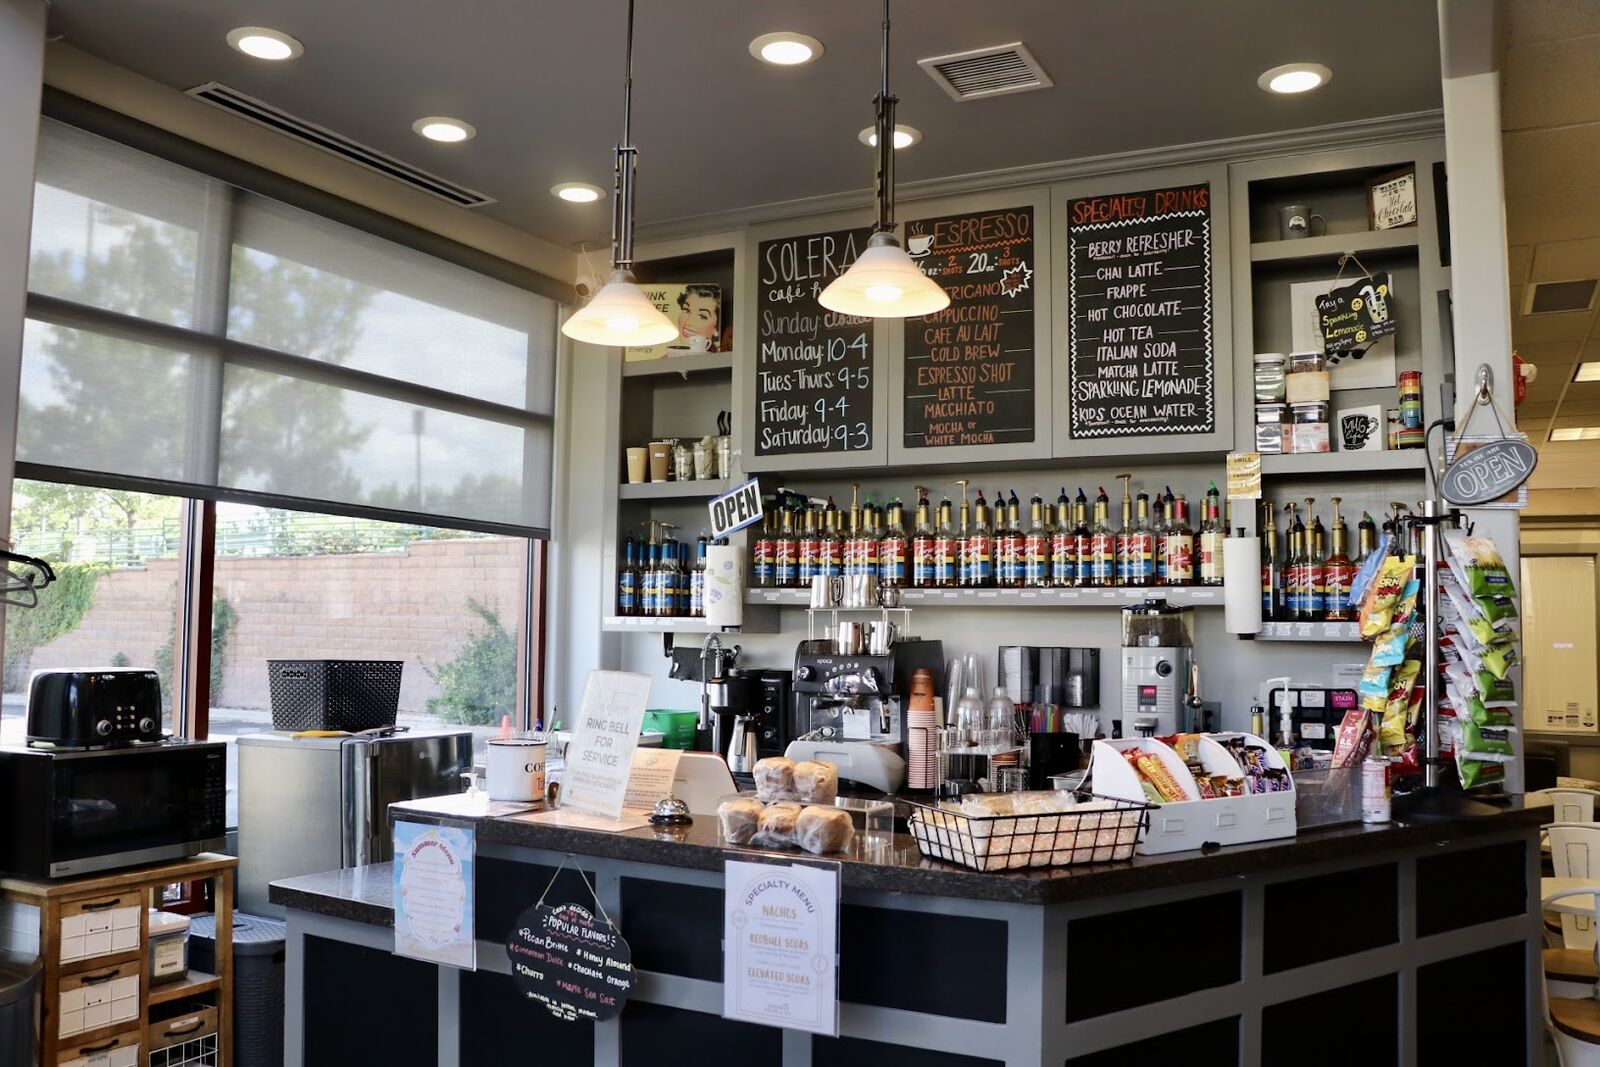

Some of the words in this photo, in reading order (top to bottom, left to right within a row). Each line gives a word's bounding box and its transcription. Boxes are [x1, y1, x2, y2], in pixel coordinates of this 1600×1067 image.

[1072, 196, 1146, 224] SPECIALTY
[1155, 188, 1209, 215] DRINKS
[934, 213, 1029, 248] ESPRESSO
[1003, 246, 1010, 257] 3
[1088, 240, 1121, 258] BERRY
[1126, 229, 1195, 253] REFRESHER
[763, 233, 858, 285] SOLERA
[948, 255, 956, 266] 2
[1097, 267, 1122, 280] CHAI
[1128, 262, 1163, 278] LATTE
[1107, 284, 1147, 300] FRAPPE
[923, 305, 998, 323] CAPPUCCINO
[1088, 308, 1108, 321] HOT
[1114, 300, 1181, 319] CHOCOLATE
[924, 327, 954, 344] CAFE
[956, 325, 970, 343] AU
[974, 322, 1004, 341] LAIT
[1103, 328, 1125, 343] HOT
[1129, 326, 1153, 340] TEA
[762, 340, 825, 367] Monday:
[827, 332, 868, 362] 10-4
[931, 346, 960, 361] COLD
[965, 344, 1000, 361] BREW
[1097, 345, 1137, 361] ITALIAN
[1143, 342, 1176, 359] SODA
[838, 366, 869, 389] 9-5
[918, 366, 976, 386] ESPRESSO
[979, 362, 1016, 383] SHOT
[1098, 365, 1138, 379] MATCHA
[1143, 361, 1178, 376] LATTE
[939, 385, 975, 400] LATTE
[1078, 380, 1139, 401] SPARKLING
[1142, 377, 1202, 398] LEMONADE
[761, 400, 809, 425] Friday:
[815, 396, 850, 423] 9-4
[924, 401, 994, 418] MACCHIATO
[1079, 407, 1105, 422] KIDS
[1110, 405, 1147, 420] OCEAN
[1154, 403, 1198, 417] WATER
[761, 424, 834, 449] Saturday:
[834, 422, 869, 450] 9-3
[929, 422, 963, 434] MOCHA
[967, 421, 976, 430] or
[924, 435, 955, 446] WHITE
[960, 433, 994, 444] MOCHA
[1453, 446, 1527, 498] OPEN
[713, 485, 759, 532] OPEN
[1325, 572, 1348, 587] Torani
[586, 718, 608, 731] RING
[609, 722, 630, 735] BELL
[594, 736, 613, 748] FOR
[582, 750, 619, 766] SERVICE
[412, 840, 438, 858] Summer
[745, 879, 790, 907] SPECIALTY
[791, 886, 815, 914] MENU
[762, 905, 797, 919] NACHOS
[548, 916, 579, 936] POPULAR
[581, 927, 611, 944] FLAVORS!
[785, 938, 809, 951] SODAS
[583, 950, 603, 968] Honey
[605, 957, 631, 972] Almond
[748, 967, 784, 981] ELEVATED
[786, 974, 810, 986] SODAS
